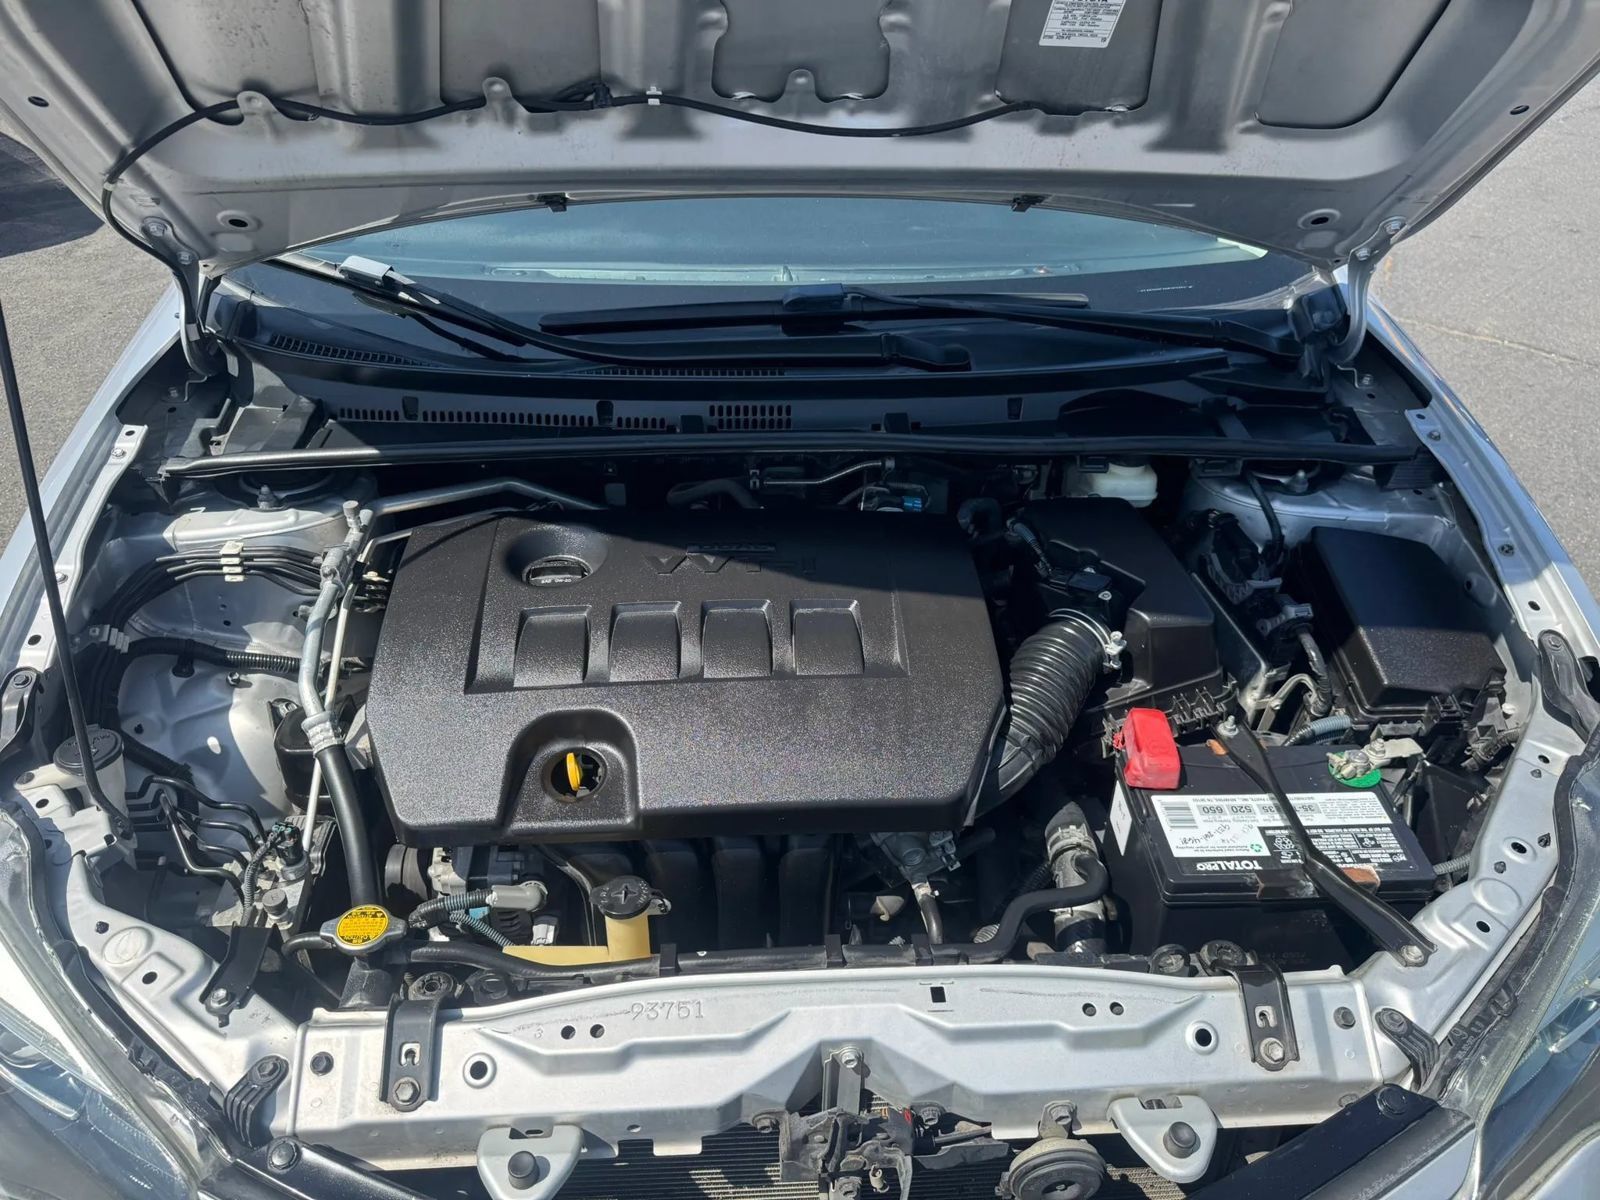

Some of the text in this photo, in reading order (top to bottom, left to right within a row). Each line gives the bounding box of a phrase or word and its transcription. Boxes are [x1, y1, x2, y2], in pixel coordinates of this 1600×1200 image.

[1202, 805, 1224, 814] 650
[1230, 805, 1252, 813] 520
[1262, 805, 1276, 813] 35
[1196, 860, 1263, 871] TOTALPRO
[631, 1000, 704, 1020] 93751
